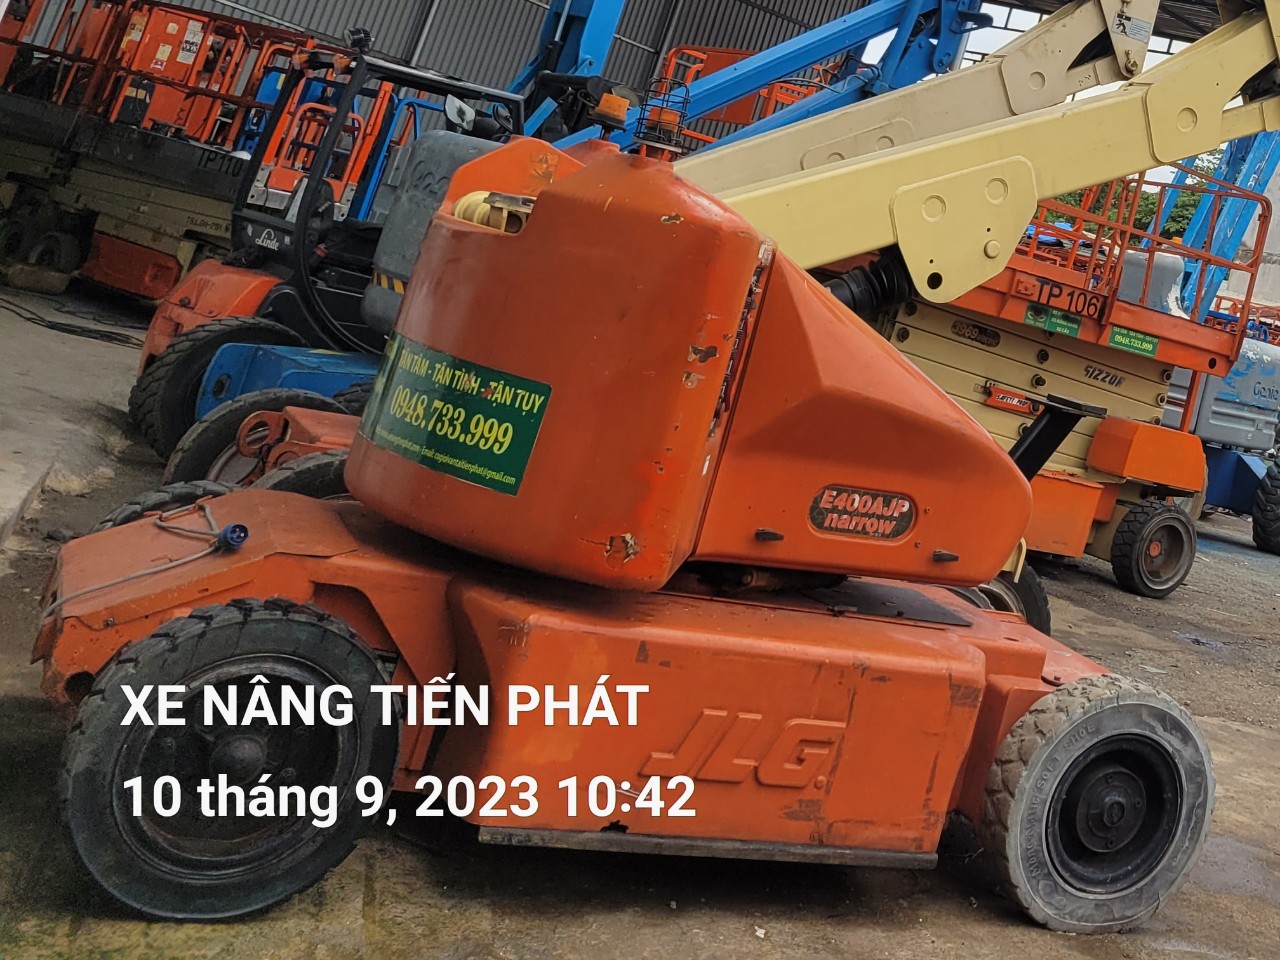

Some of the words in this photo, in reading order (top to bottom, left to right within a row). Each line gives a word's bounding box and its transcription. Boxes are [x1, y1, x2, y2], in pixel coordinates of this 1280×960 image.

[255, 228, 280, 251] Linde
[432, 361, 453, 388] TẬN
[487, 380, 515, 407] TẬN
[514, 388, 546, 416] TỤY
[1253, 381, 1279, 401] Genie
[390, 385, 514, 455] 0948.733.999
[820, 489, 910, 517] E400AJP
[824, 513, 897, 534] narrow
[637, 708, 847, 789] JLG
